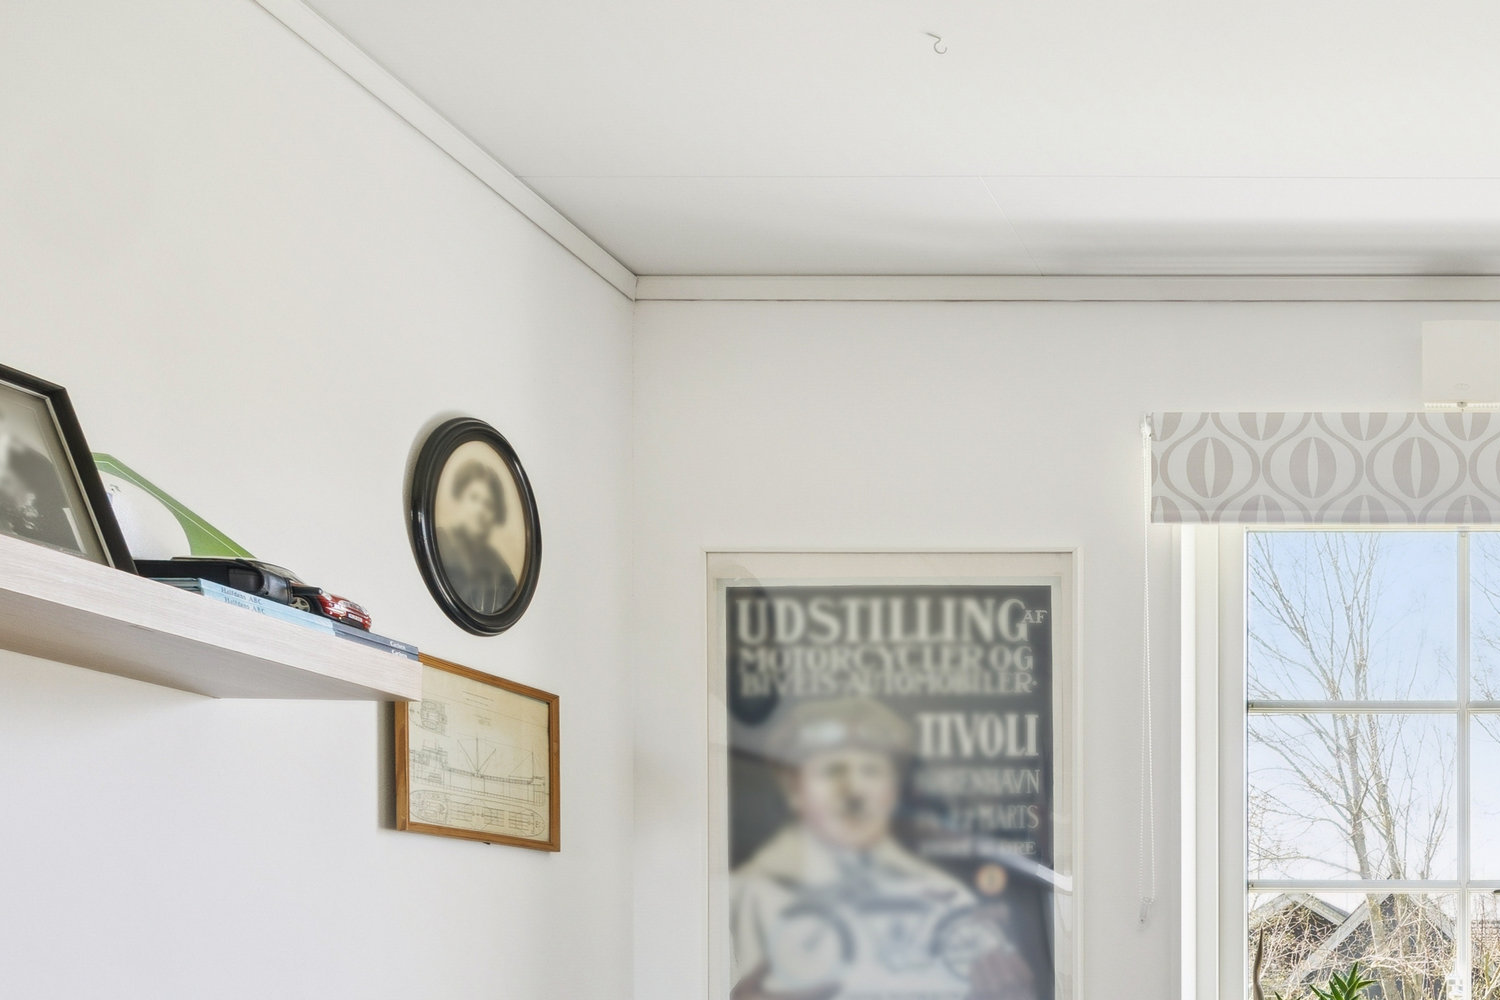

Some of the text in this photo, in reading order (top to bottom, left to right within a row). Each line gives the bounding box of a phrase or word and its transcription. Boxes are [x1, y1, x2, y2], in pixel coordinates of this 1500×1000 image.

[737, 597, 1048, 644] UDSTILLING AF
[989, 646, 1034, 671] OG
[918, 712, 1039, 758] TIVOLI
